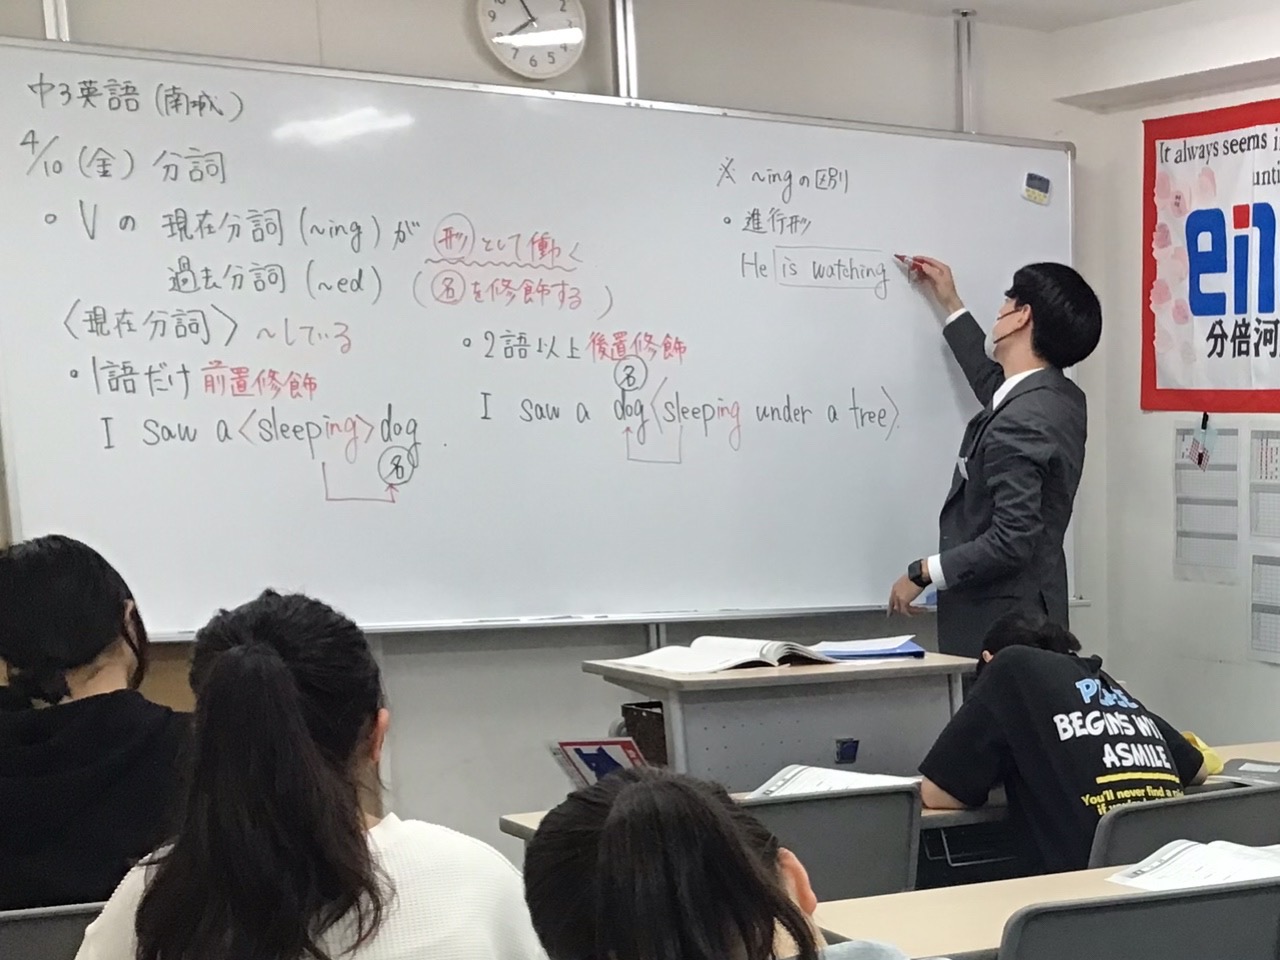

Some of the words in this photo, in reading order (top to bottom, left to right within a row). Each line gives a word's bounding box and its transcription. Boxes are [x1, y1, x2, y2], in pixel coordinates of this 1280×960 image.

[488, 10, 496, 21] 9
[511, 47, 519, 60] 7
[529, 55, 538, 67] 6
[547, 52, 556, 64] 5
[27, 72, 140, 112] 中3英語
[1159, 140, 1171, 164] It
[1174, 139, 1219, 165] always
[1222, 131, 1268, 156] seems
[153, 147, 226, 184] 分詞
[161, 207, 286, 246] 現在分詞
[741, 207, 812, 235] 進行形
[167, 256, 286, 294] 過去分詞
[741, 252, 768, 279] He
[782, 256, 798, 277] is
[812, 256, 889, 300] watching
[586, 331, 687, 362] 後置修飾
[200, 360, 318, 400] 前置修飾
[480, 392, 492, 420] I
[577, 404, 590, 422] a
[613, 388, 646, 445] dog
[756, 402, 813, 424] under
[827, 405, 839, 422] a
[100, 417, 115, 449] I
[1053, 710, 1136, 741] BEGINS
[1081, 789, 1115, 806] You'll
[1116, 789, 1145, 799] never
[1146, 785, 1165, 797] find
